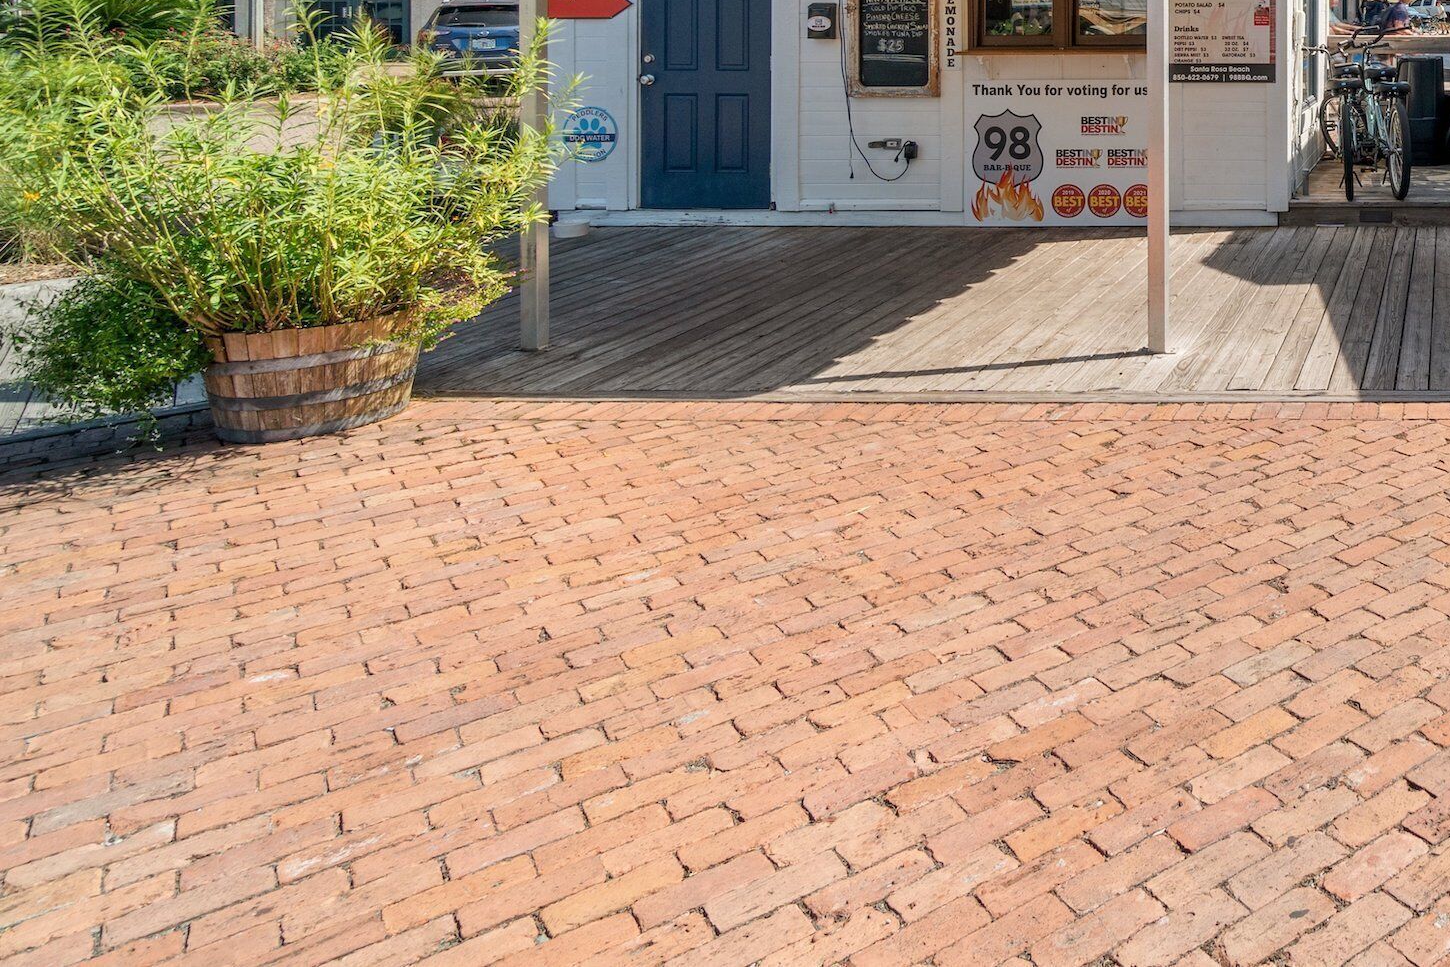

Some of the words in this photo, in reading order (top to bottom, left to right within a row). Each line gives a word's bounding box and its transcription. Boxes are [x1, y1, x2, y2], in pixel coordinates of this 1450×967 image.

[891, 11, 920, 21] CHEESE
[972, 84, 1013, 96] Thank
[1017, 84, 1041, 96] You
[1045, 84, 1062, 96] for
[1067, 84, 1107, 98] voting
[1112, 84, 1130, 96] for
[1134, 86, 1148, 96] us
[1081, 125, 1118, 133] DESTIN
[984, 126, 1031, 161] 98
[1056, 158, 1093, 166] DESTIN
[1107, 158, 1145, 166] DESTIN
[1053, 196, 1084, 207] BEST
[1089, 196, 1120, 207] BEST
[1125, 196, 1148, 207] BES
